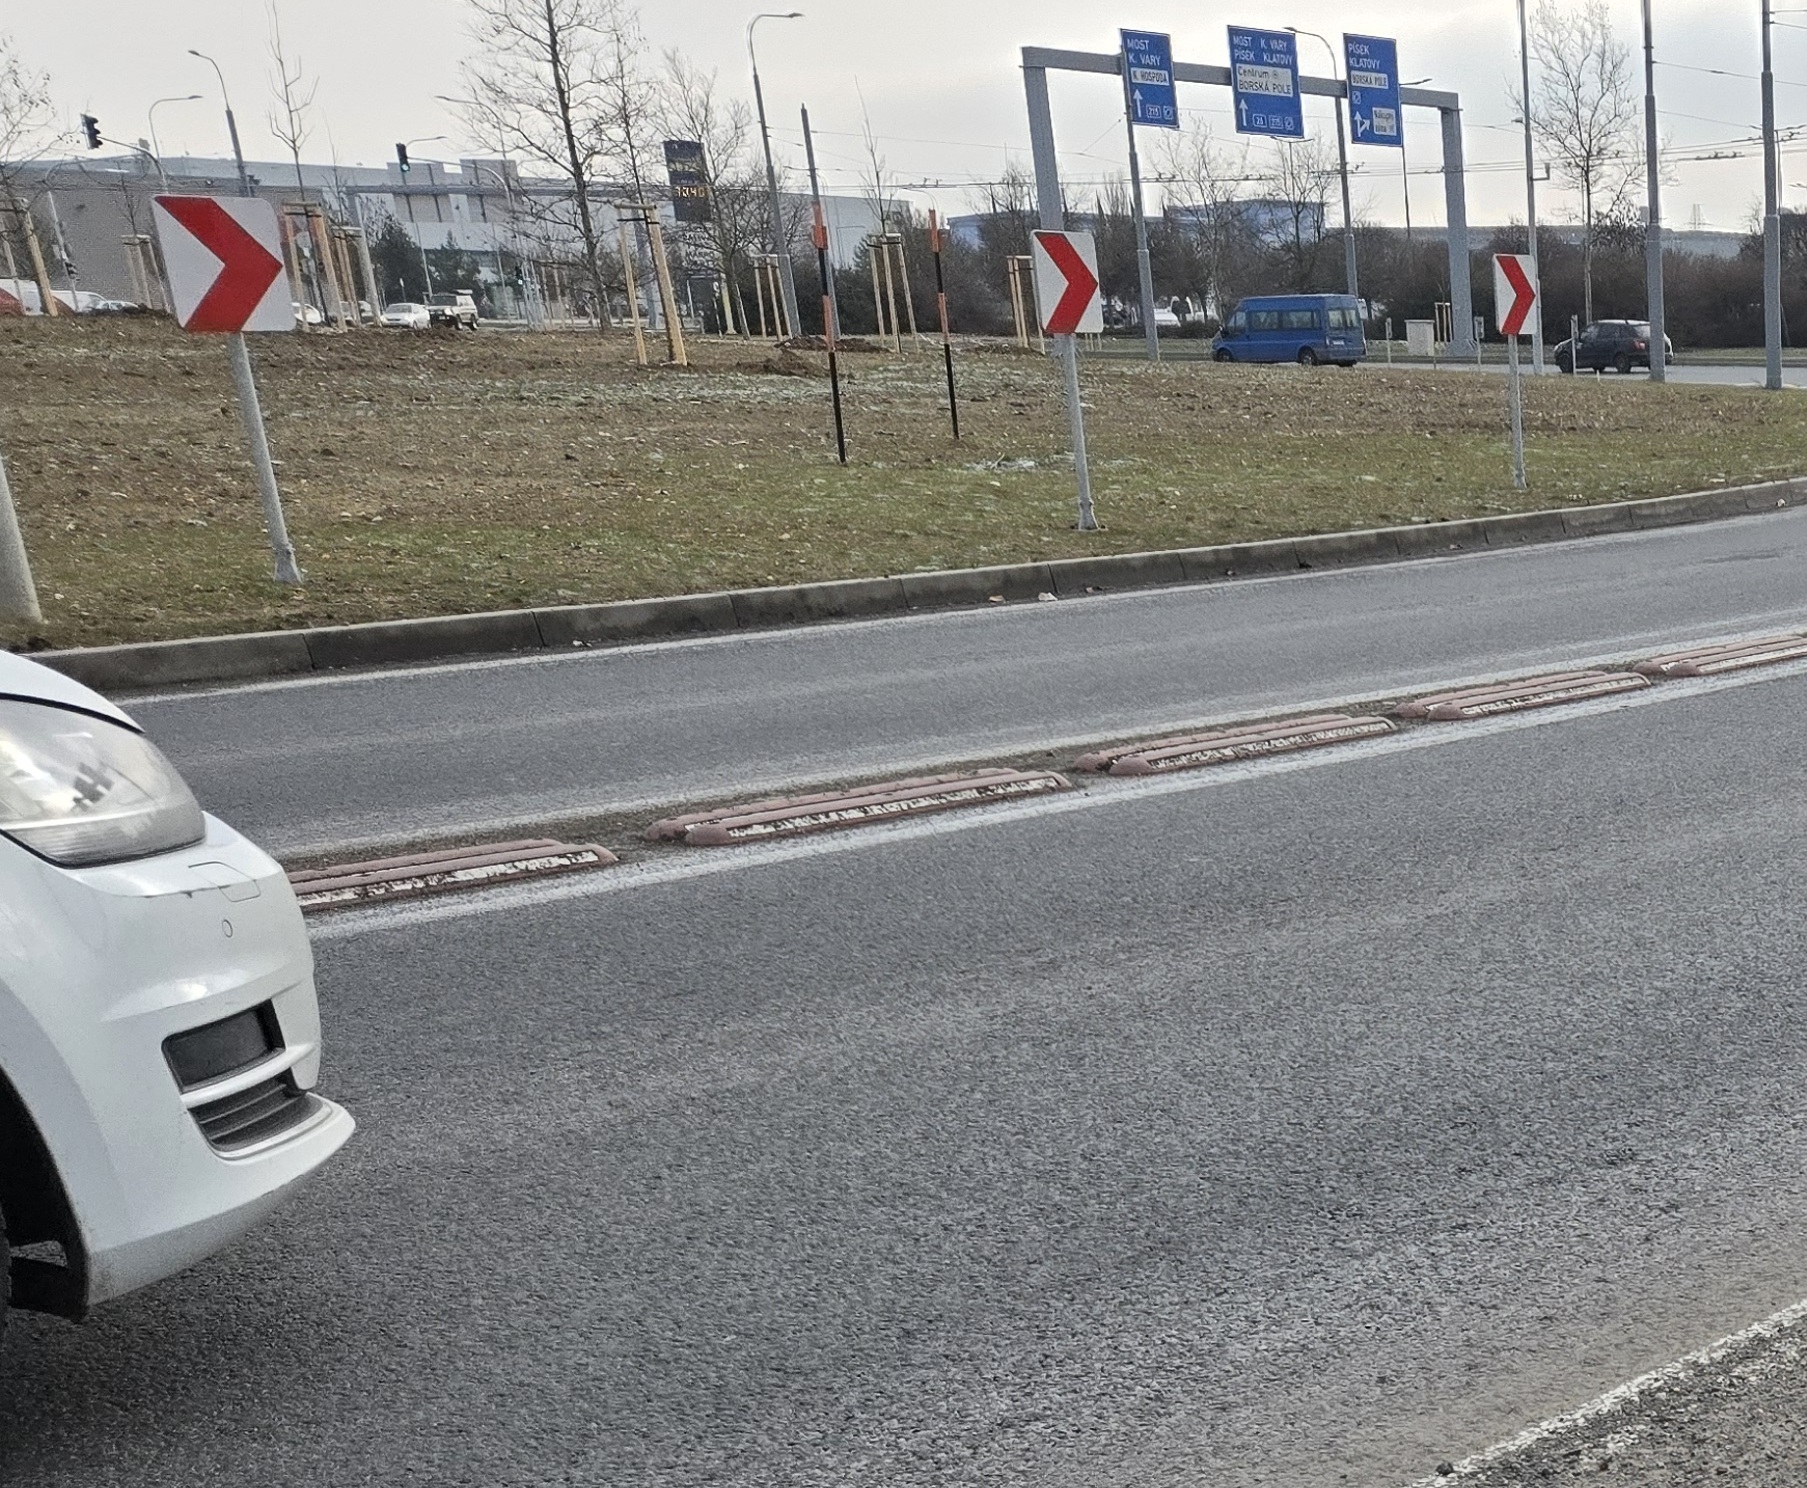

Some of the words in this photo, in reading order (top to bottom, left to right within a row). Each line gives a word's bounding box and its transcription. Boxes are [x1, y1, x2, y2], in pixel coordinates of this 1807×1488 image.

[1127, 38, 1149, 51] MOST
[1233, 35, 1252, 47] MOST
[1269, 40, 1288, 52] VARY
[1347, 41, 1370, 55] PÍSEK
[1140, 54, 1161, 66] VARY
[1263, 52, 1293, 65] KLATOVY
[1349, 58, 1380, 69] KLATOVY
[1238, 66, 1269, 79] Centrum
[1272, 83, 1291, 95] POLE
